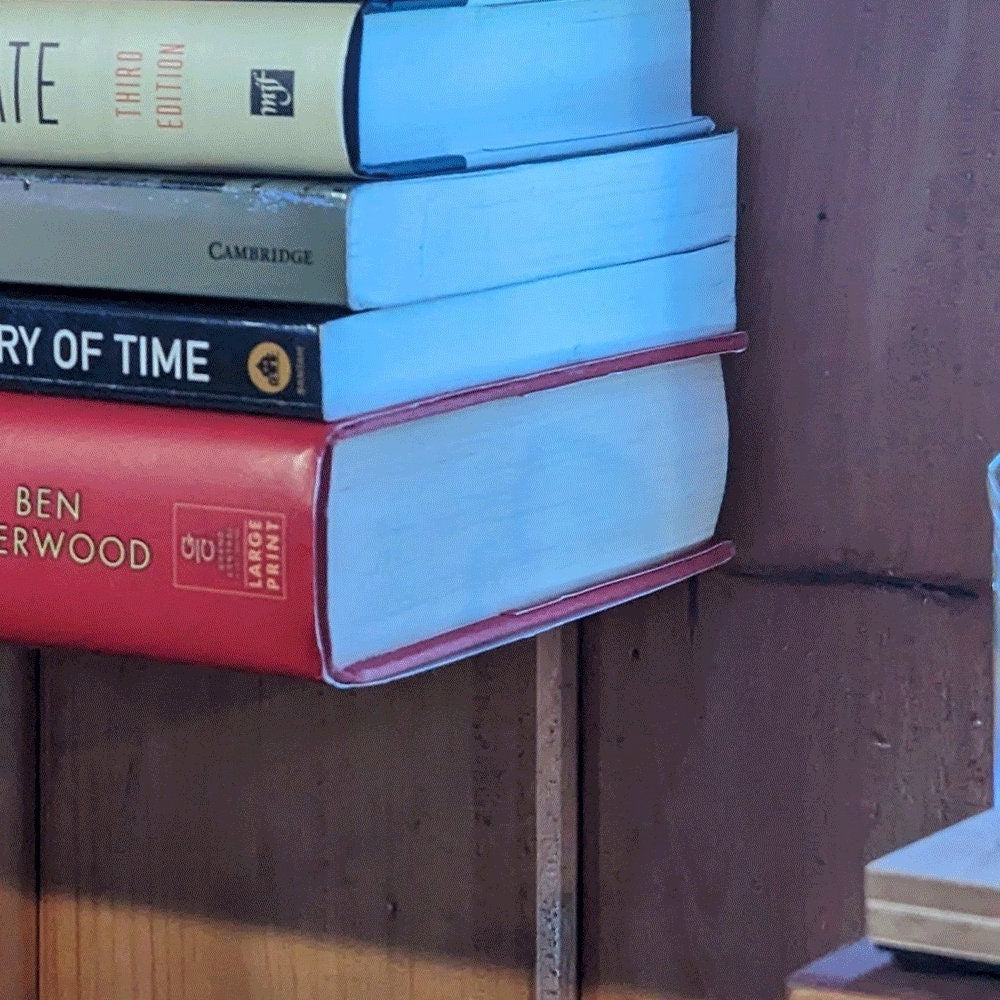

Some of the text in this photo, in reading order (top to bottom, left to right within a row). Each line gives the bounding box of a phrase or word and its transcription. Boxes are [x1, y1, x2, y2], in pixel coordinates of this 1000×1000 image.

[115, 49, 142, 117] THIRD
[157, 42, 185, 130] EDITION
[53, 331, 103, 371] OF
[114, 334, 211, 382] TIME
[15, 486, 81, 521] BEN
[248, 519, 263, 588] LARGE
[265, 521, 280, 590] PRINT
